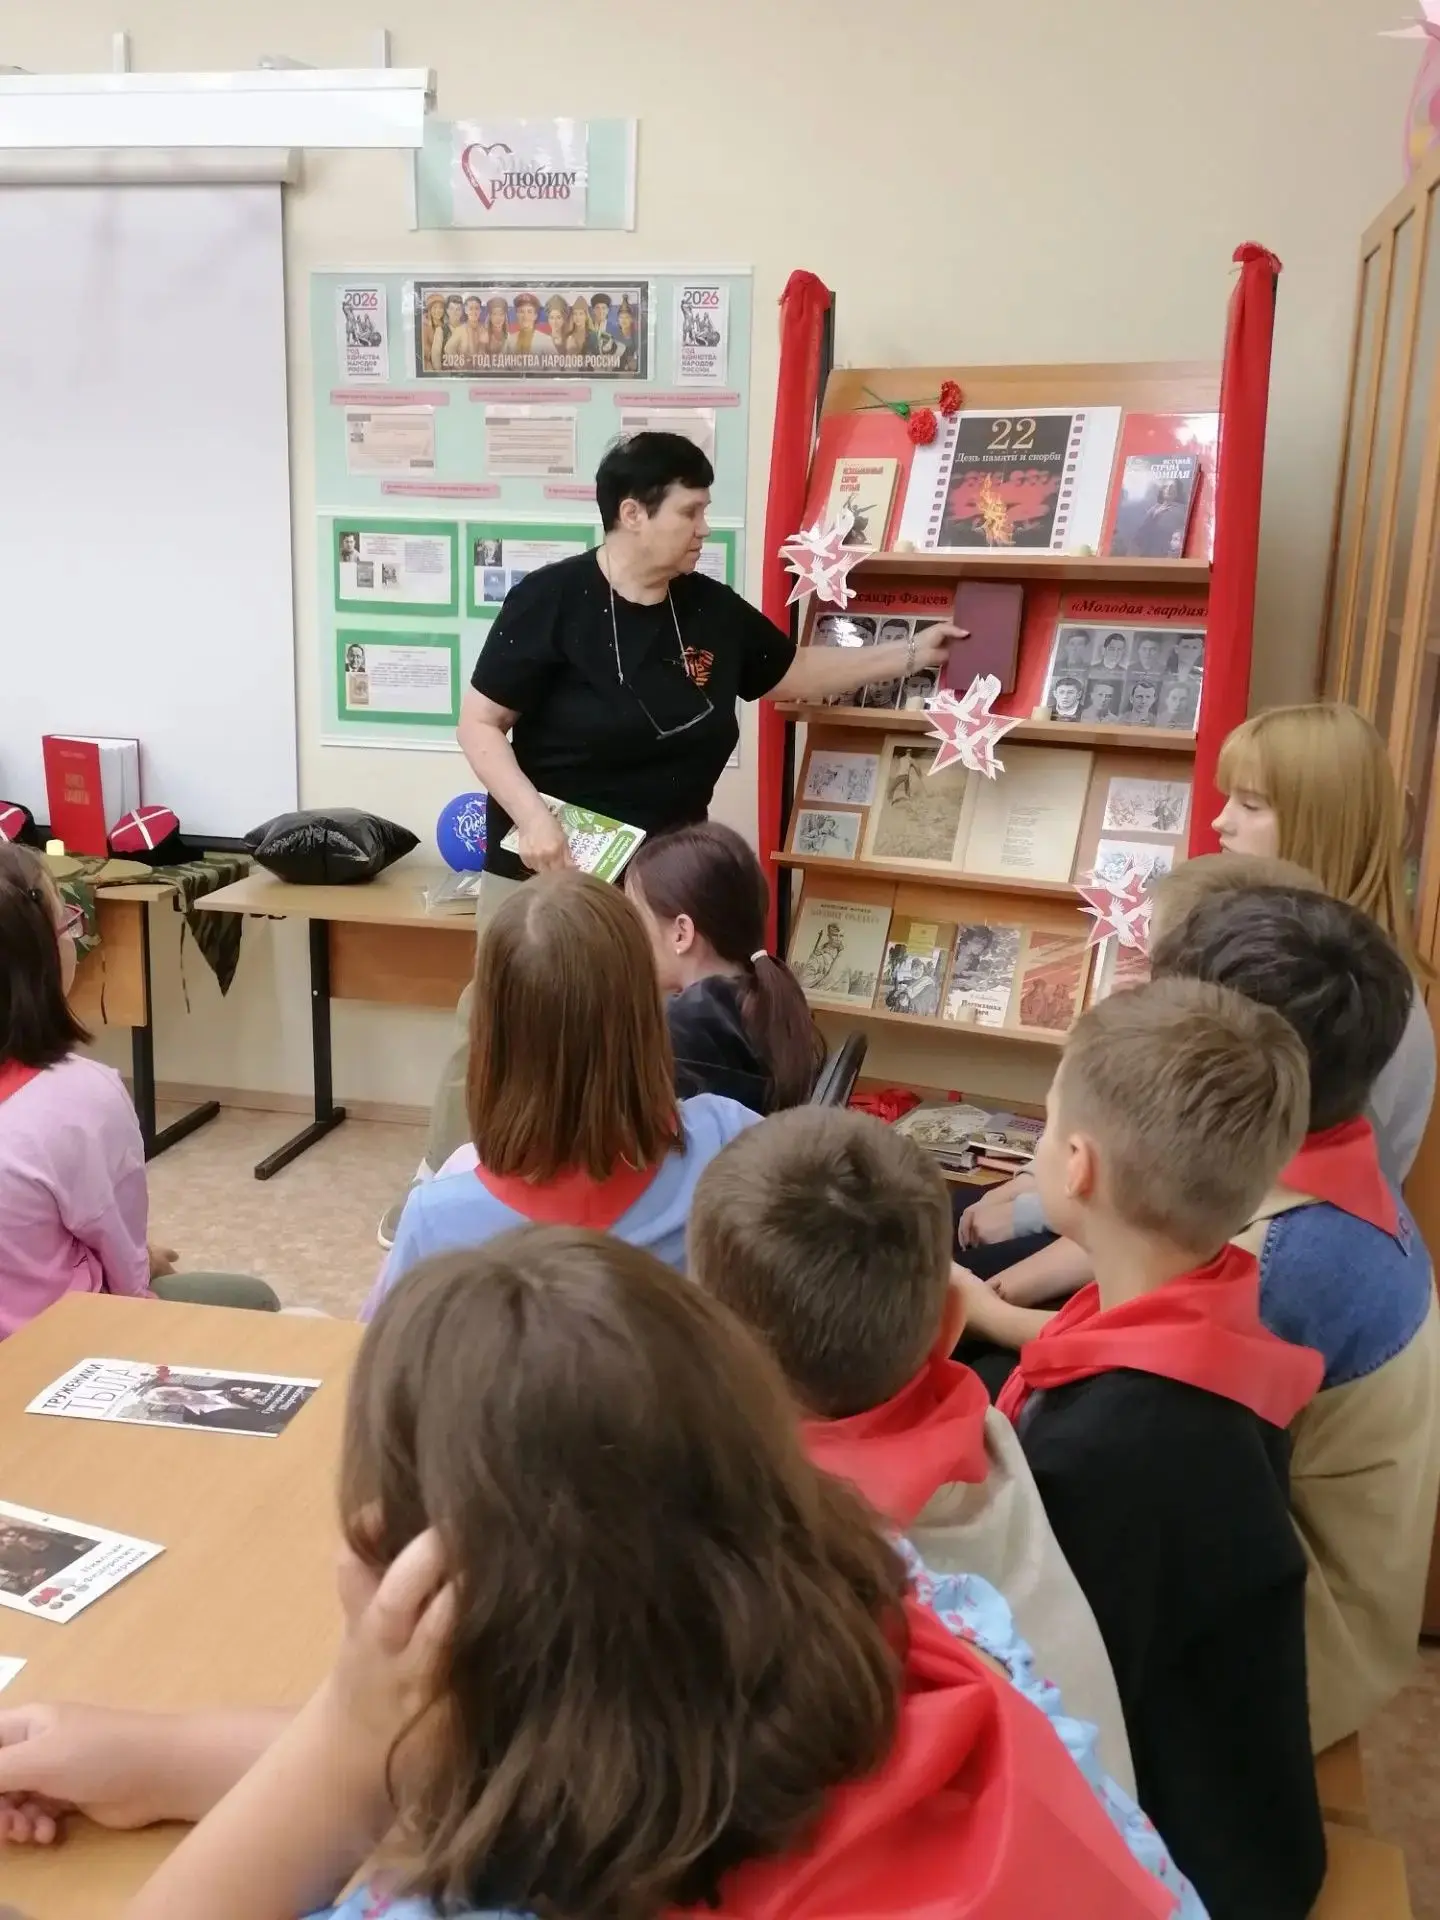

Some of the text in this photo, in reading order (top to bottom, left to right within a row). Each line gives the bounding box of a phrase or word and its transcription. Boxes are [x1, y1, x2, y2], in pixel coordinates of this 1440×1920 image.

[344, 292, 378, 307] 2026
[684, 291, 719, 305] 2026
[442, 354, 465, 367] 2026
[472, 354, 491, 368] ГОД
[492, 354, 540, 368] ЕДИНСТВА
[541, 354, 583, 368] НАРОДОВ
[585, 354, 621, 368] РОССИИ
[987, 418, 1037, 449] 22
[955, 451, 1061, 463] День памяти и скорби
[900, 592, 948, 605] Фадеев
[1071, 599, 1144, 615] «Молодая
[41, 1363, 105, 1409] ТРУЖЕНИКИ
[61, 1369, 140, 1411] ТЫЛА
